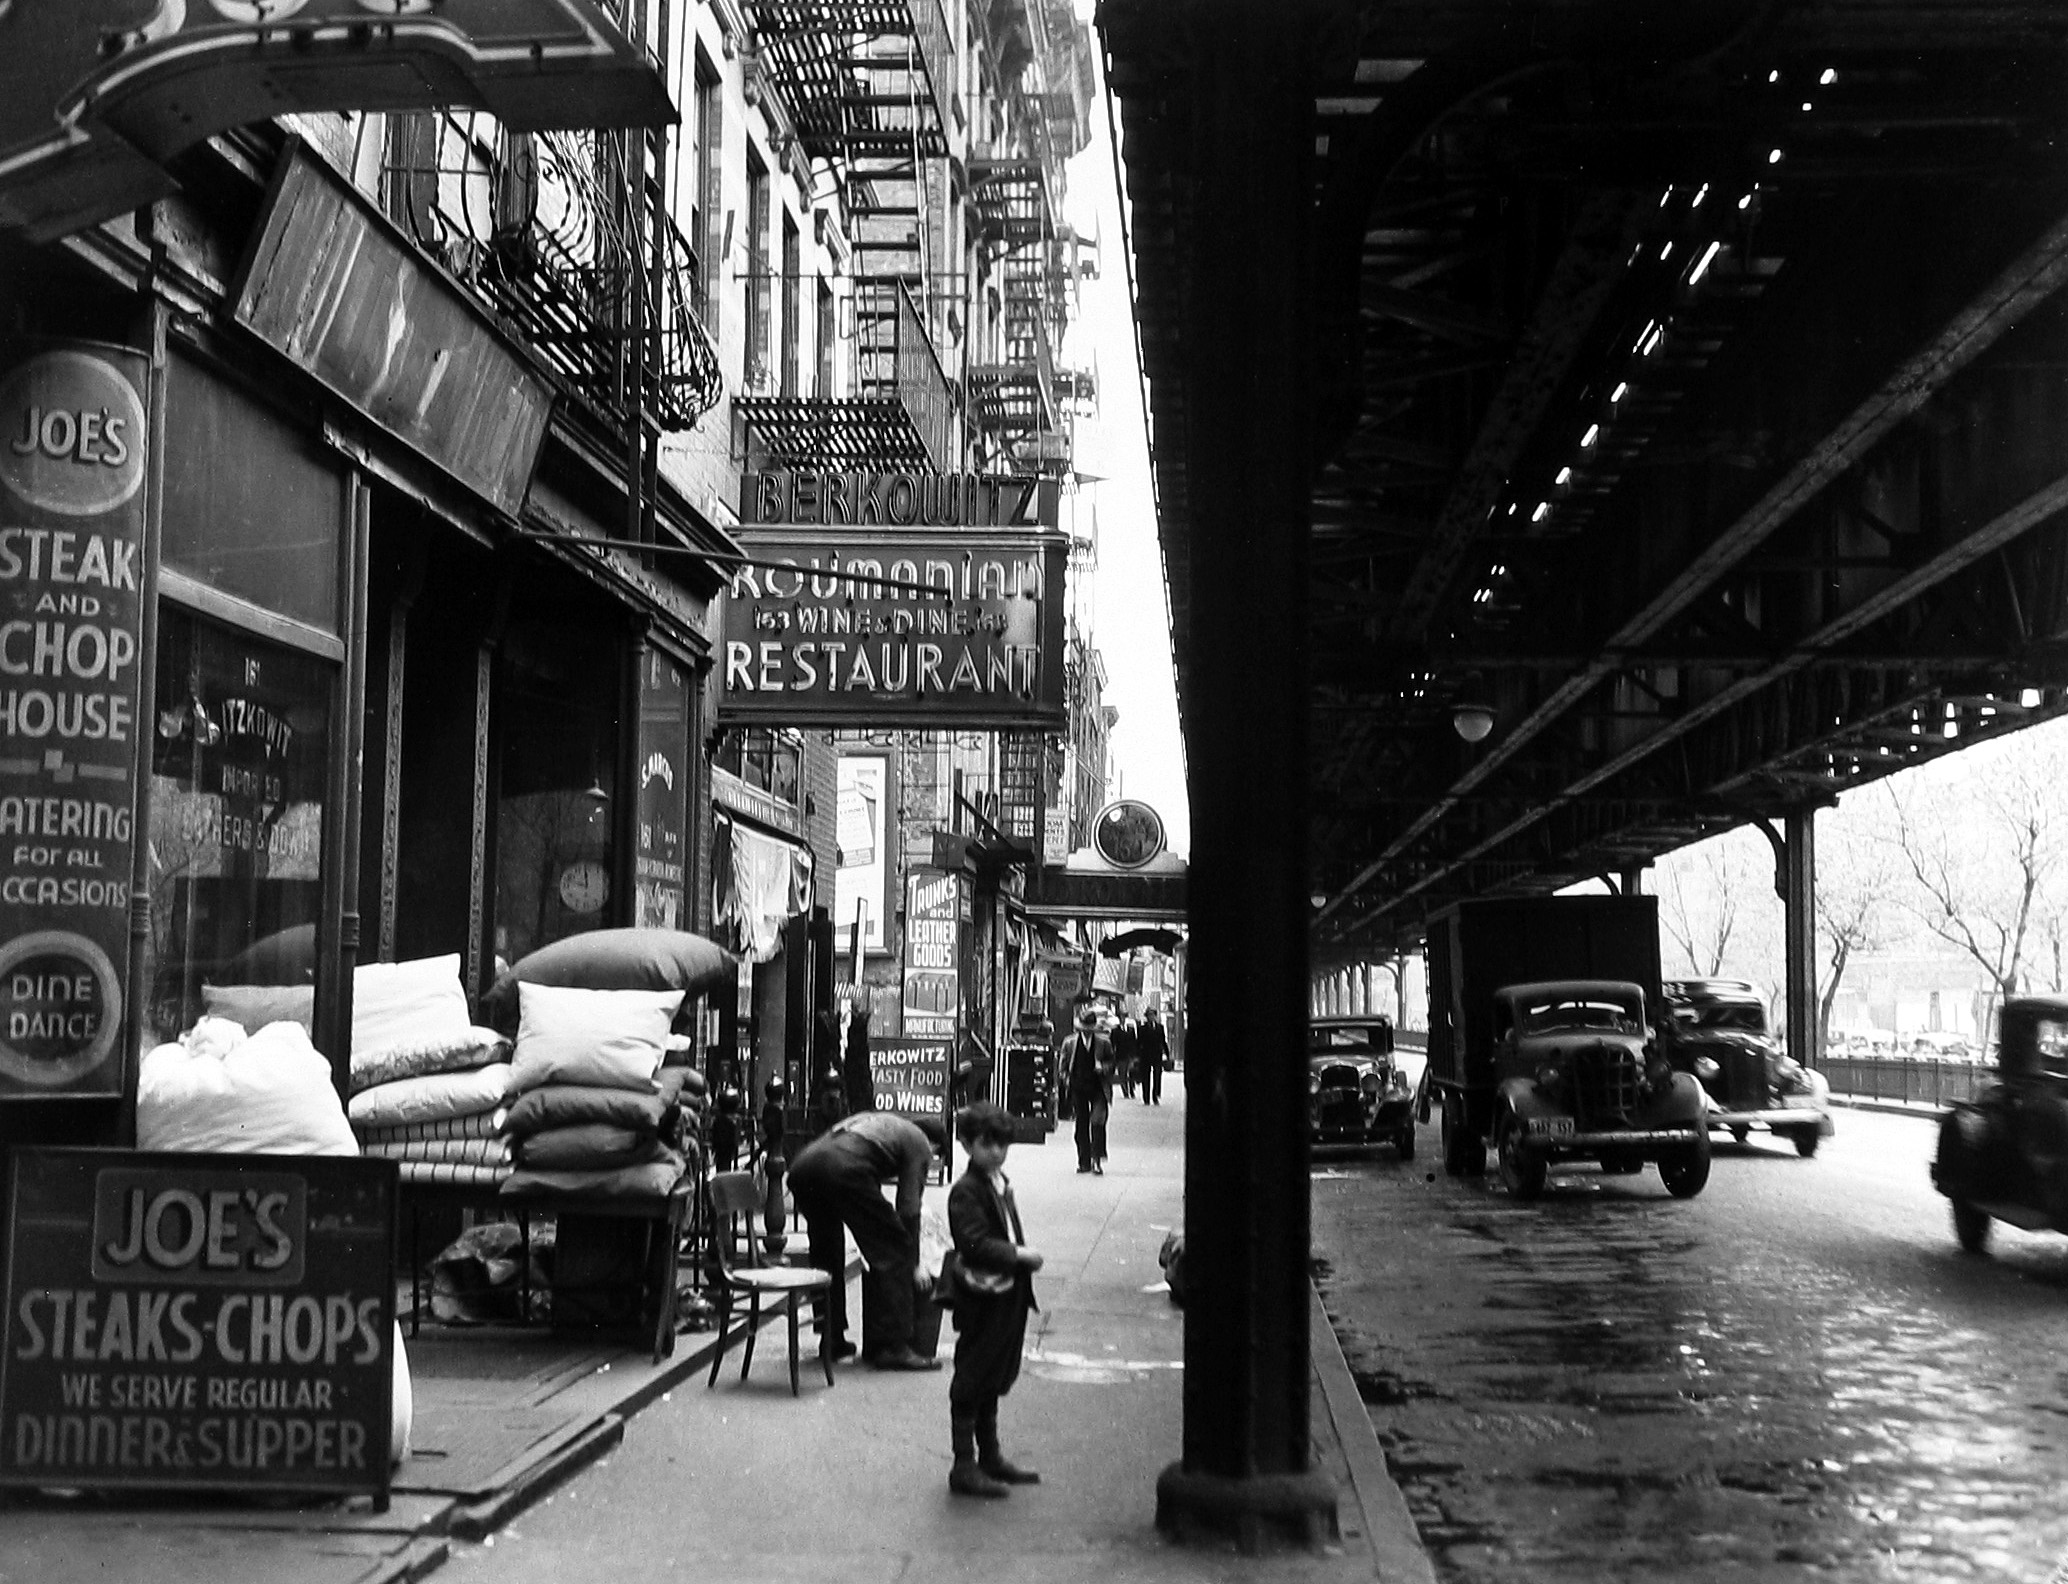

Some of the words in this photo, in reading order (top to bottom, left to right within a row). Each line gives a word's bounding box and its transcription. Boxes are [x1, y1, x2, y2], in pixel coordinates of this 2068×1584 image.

[12, 405, 129, 467] JOE'S
[756, 469, 1039, 526] BERKOWITZ
[0, 528, 136, 591] STEAK
[35, 593, 100, 617] AND
[798, 606, 871, 634] WINE
[893, 607, 967, 635] DINE
[0, 620, 134, 681] CHOP
[726, 640, 1039, 694] RESTAURANT
[67, 850, 103, 868] ALL
[908, 873, 957, 917] TRUNKS
[929, 900, 953, 918] and
[908, 919, 956, 944] LEATHER
[913, 943, 952, 967] GOODS
[11, 974, 94, 1002] DINE
[9, 1010, 98, 1040] DANCE
[910, 1067, 943, 1090] FOOD
[897, 1090, 944, 1113] WINES
[106, 1188, 292, 1268] JOE'S
[61, 1373, 101, 1408] WE
[111, 1375, 197, 1410] SERVE
[207, 1377, 333, 1411] REGULAR
